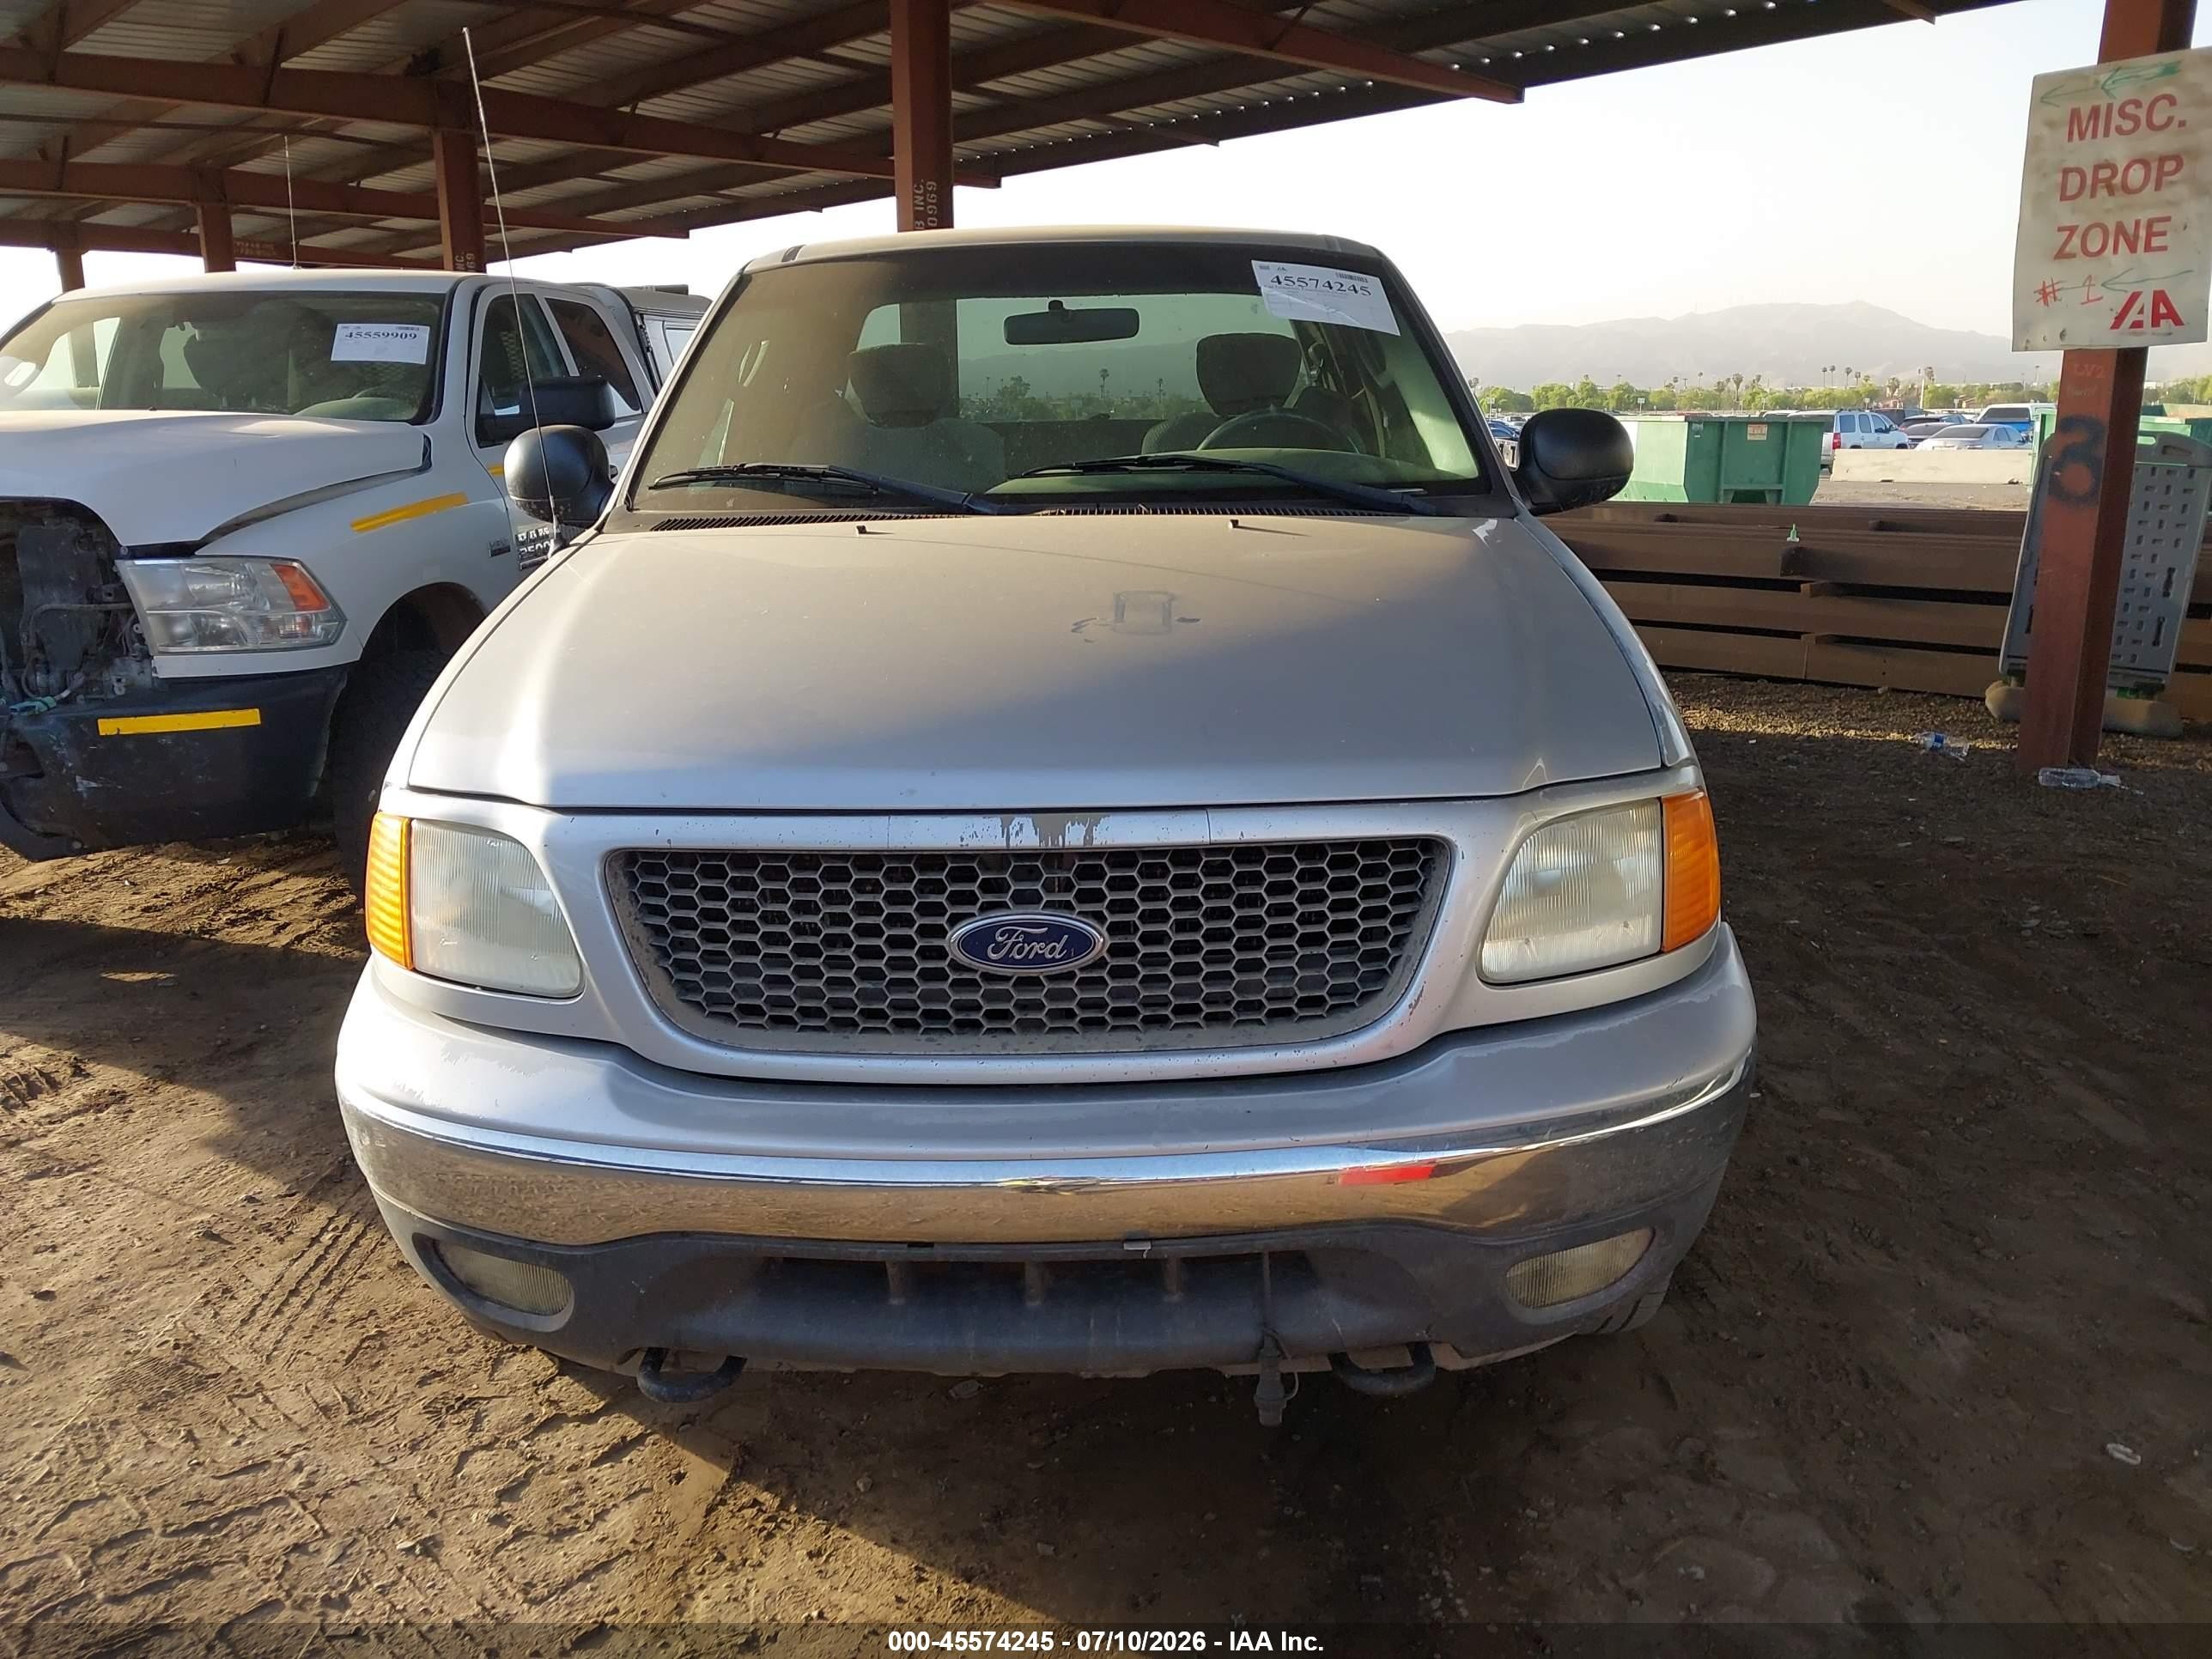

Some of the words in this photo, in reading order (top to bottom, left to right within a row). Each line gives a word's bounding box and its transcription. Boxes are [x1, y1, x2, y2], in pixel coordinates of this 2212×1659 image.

[2067, 93, 2187, 143] MISC.
[914, 179, 925, 210] INC.
[2058, 154, 2185, 202] DROP
[2053, 215, 2172, 261] ZONE
[1270, 275, 1372, 297] 45574245
[344, 331, 418, 340] 45559909
[987, 927, 1069, 960] Ford
